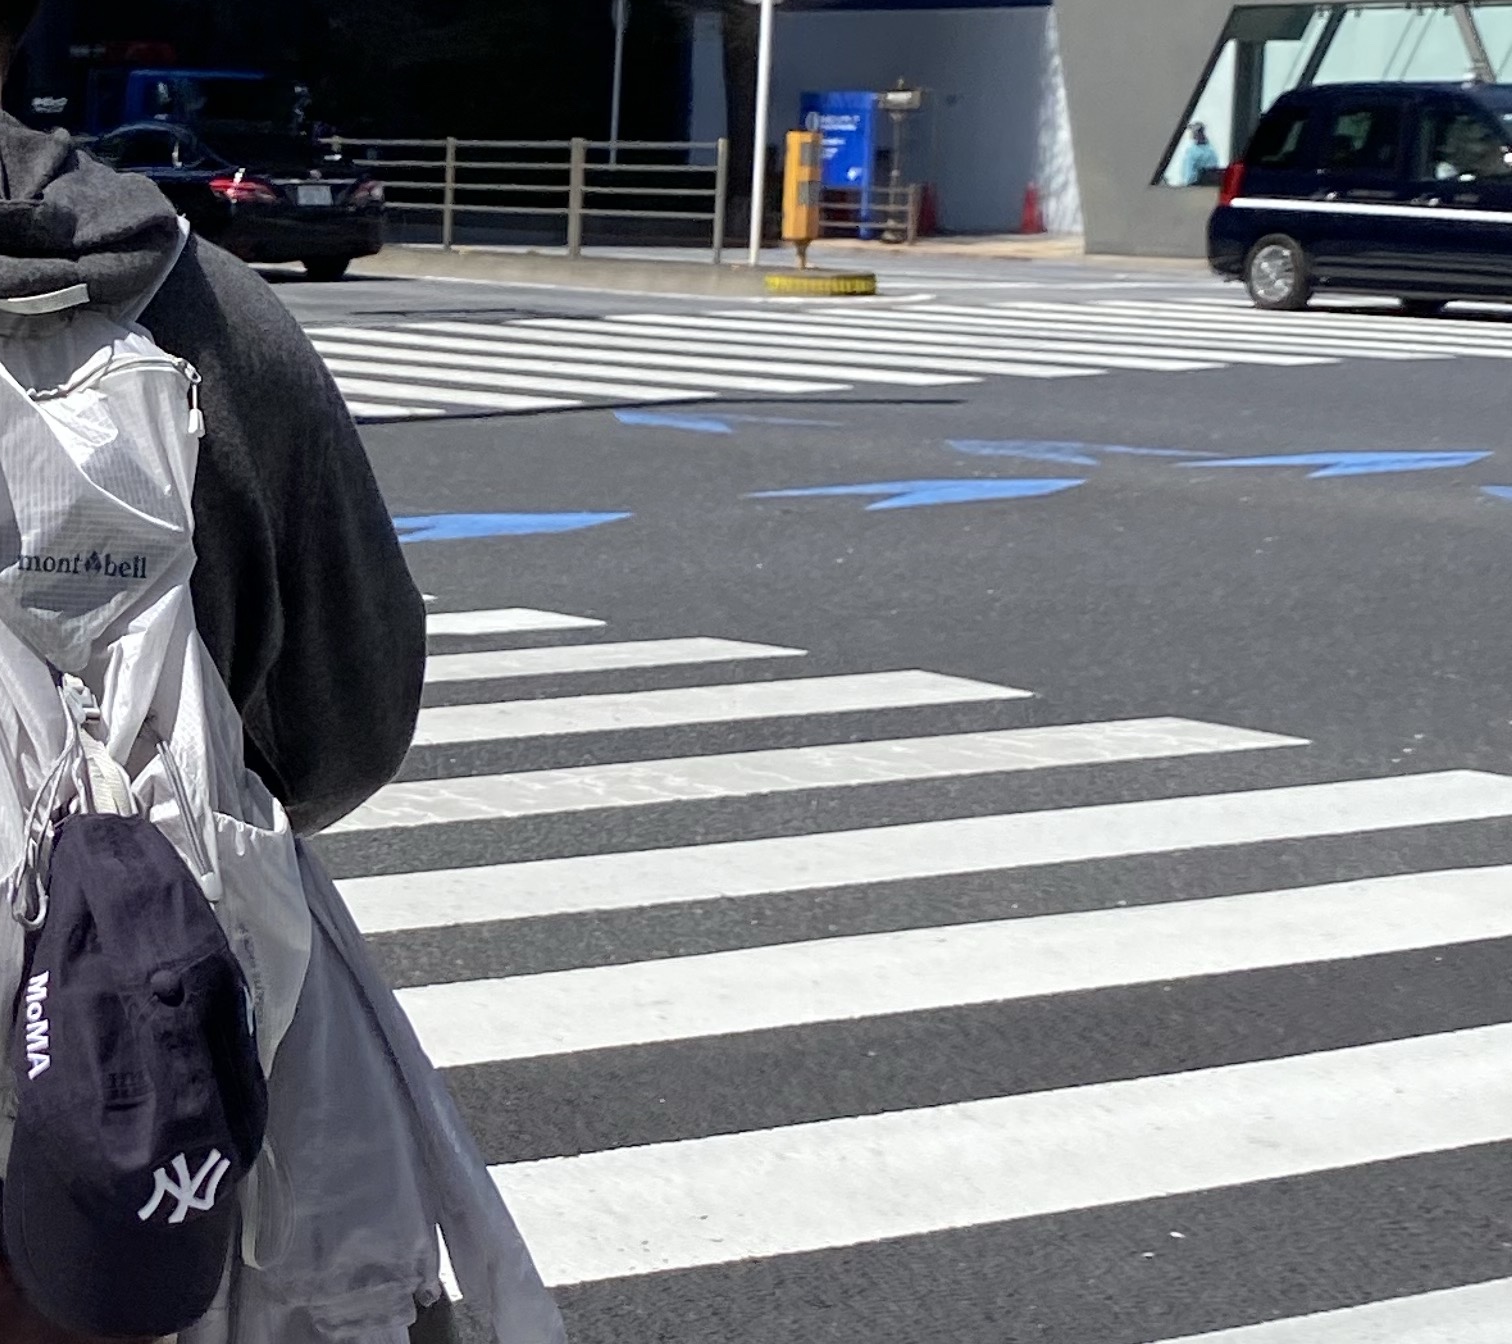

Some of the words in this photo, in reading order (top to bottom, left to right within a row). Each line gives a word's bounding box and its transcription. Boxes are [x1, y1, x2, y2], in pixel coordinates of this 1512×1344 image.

[103, 554, 147, 579] bell
[25, 970, 51, 1080] MoMA
[137, 1148, 231, 1223] NY
